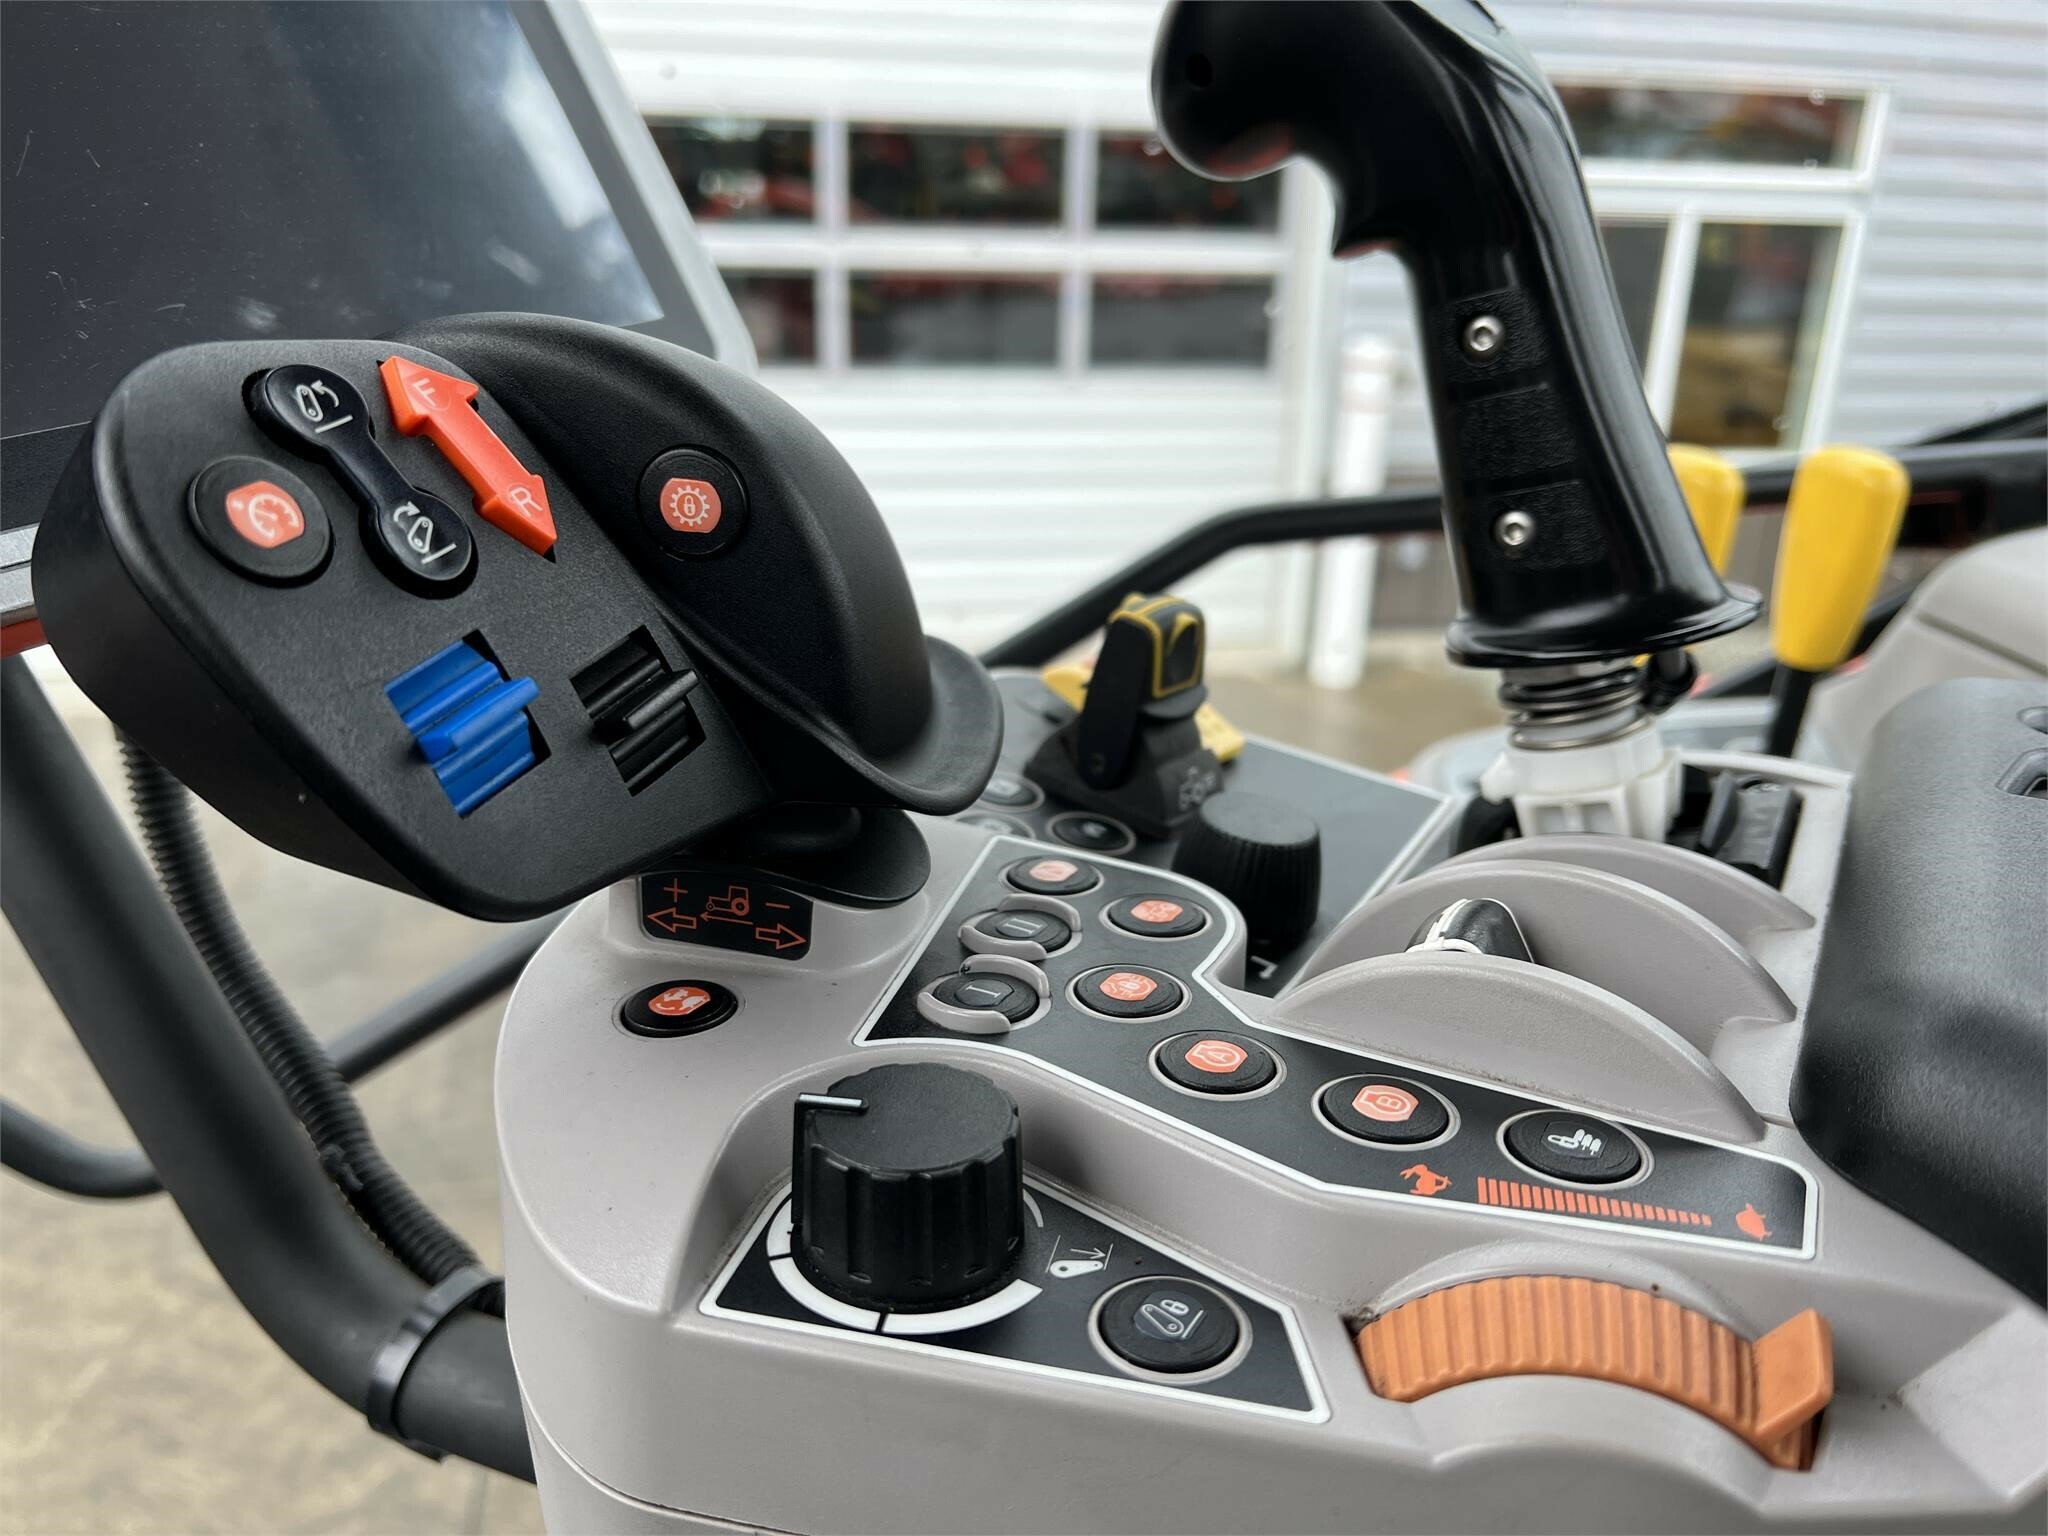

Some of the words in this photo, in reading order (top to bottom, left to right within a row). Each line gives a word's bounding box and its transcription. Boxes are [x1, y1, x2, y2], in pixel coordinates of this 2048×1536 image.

[412, 377, 437, 408] F
[509, 487, 543, 518] R
[1375, 1095, 1402, 1110] B
